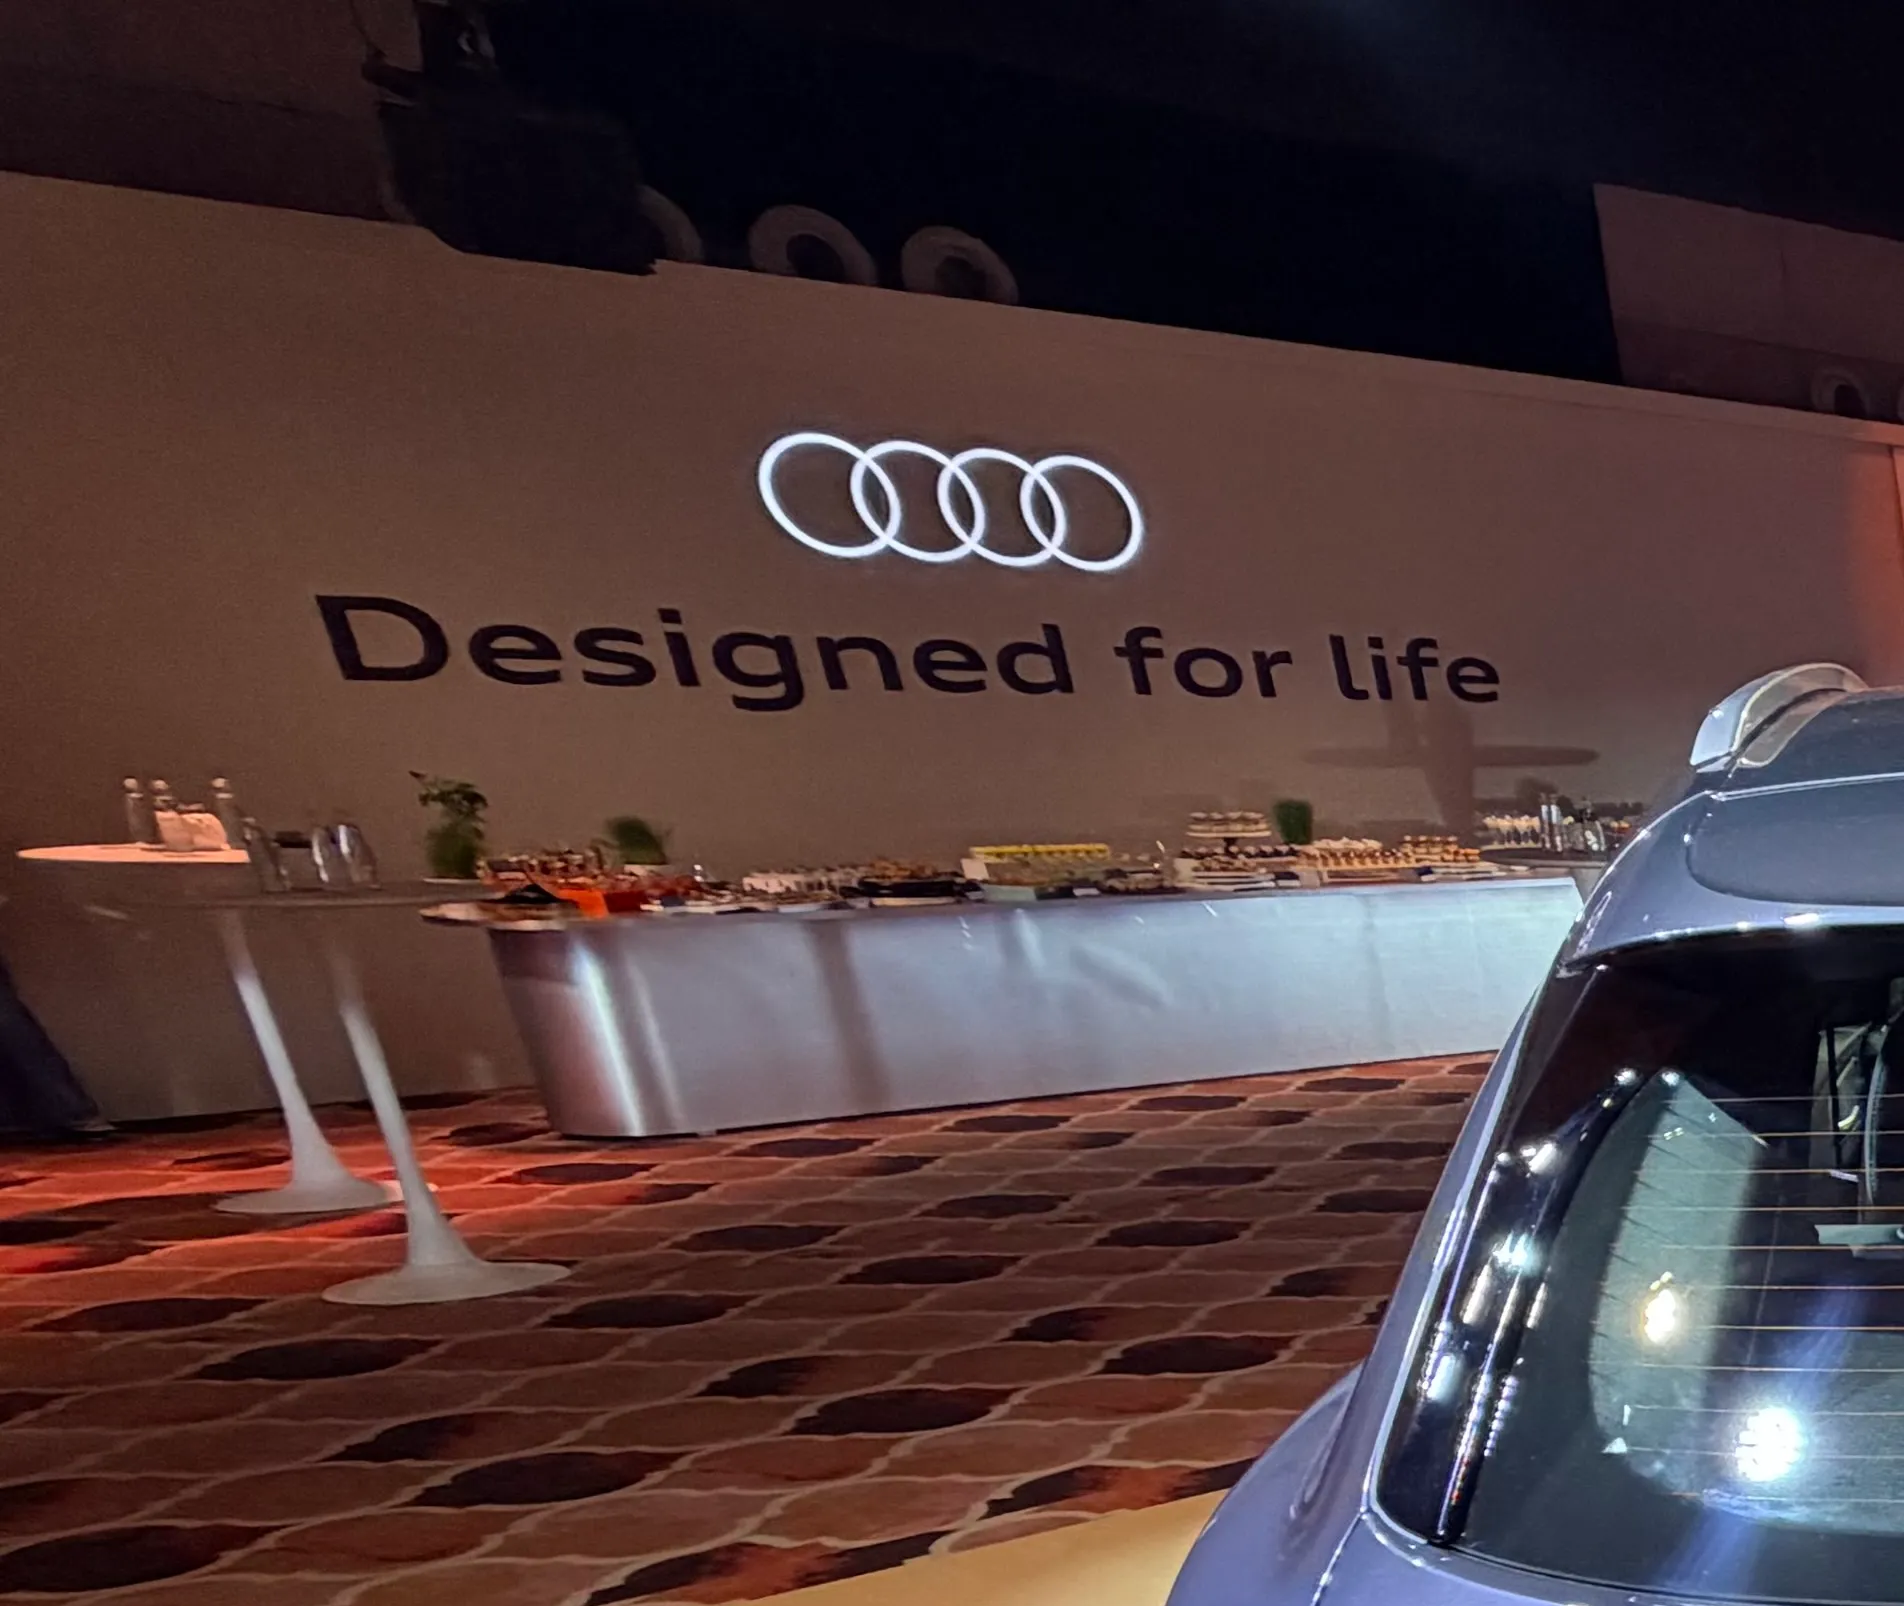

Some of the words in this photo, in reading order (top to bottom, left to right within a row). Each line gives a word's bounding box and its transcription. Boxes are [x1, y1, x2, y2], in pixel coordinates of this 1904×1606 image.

[316, 594, 1075, 712] Designed
[1113, 626, 1293, 698] for
[1329, 633, 1500, 703] life
